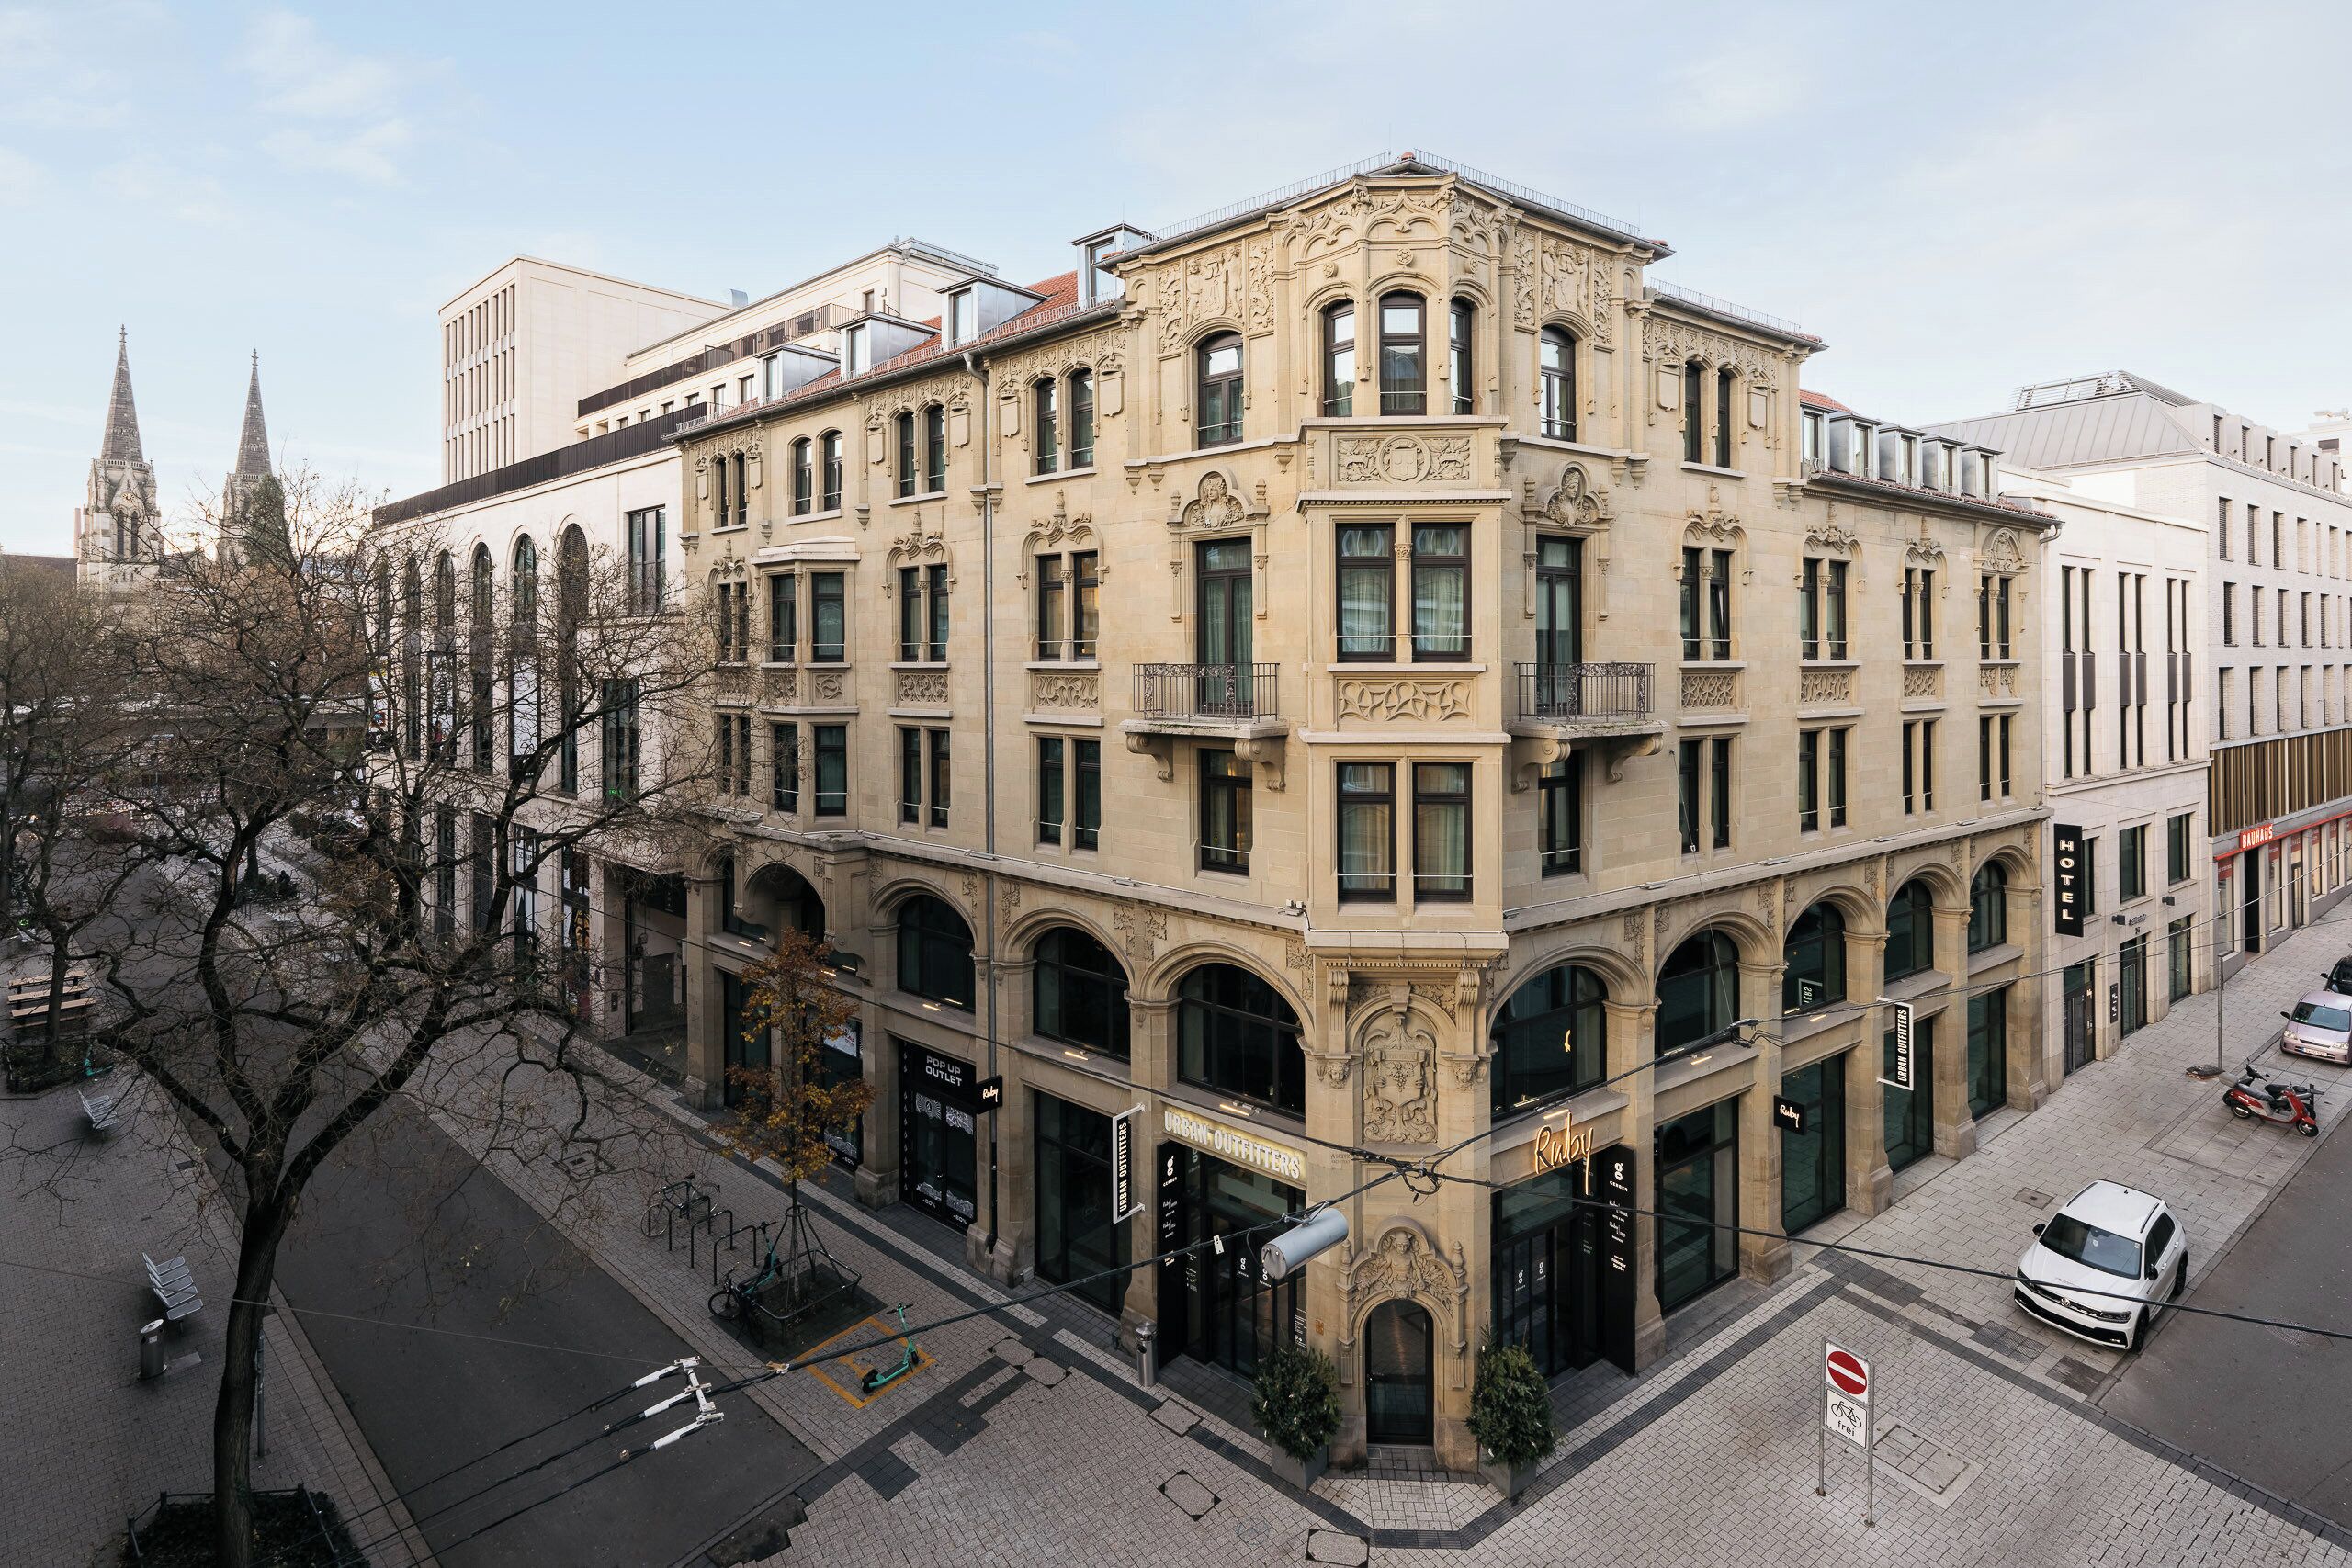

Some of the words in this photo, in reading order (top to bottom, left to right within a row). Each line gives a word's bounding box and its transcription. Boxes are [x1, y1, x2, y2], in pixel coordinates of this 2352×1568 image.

[2242, 825, 2273, 849] BAUHAUS
[2059, 840, 2075, 921] HOTEL
[1897, 1009, 1907, 1055] OUTFITTERS
[925, 1066, 963, 1087] OUTLET
[926, 1055, 946, 1069] POP
[947, 1062, 961, 1075] UP
[1897, 1055, 1907, 1082] URBAN
[982, 1085, 999, 1103] Ruby
[1779, 1104, 1801, 1129] Ruby
[1118, 1122, 1127, 1178] OUTFITTERS
[1164, 1111, 1209, 1145] URBAN
[1214, 1129, 1301, 1179] OUTFITTERS
[1534, 1111, 1594, 1196] Ruby
[1118, 1179, 1127, 1213] URBAN
[1838, 1420, 1855, 1436] frei
